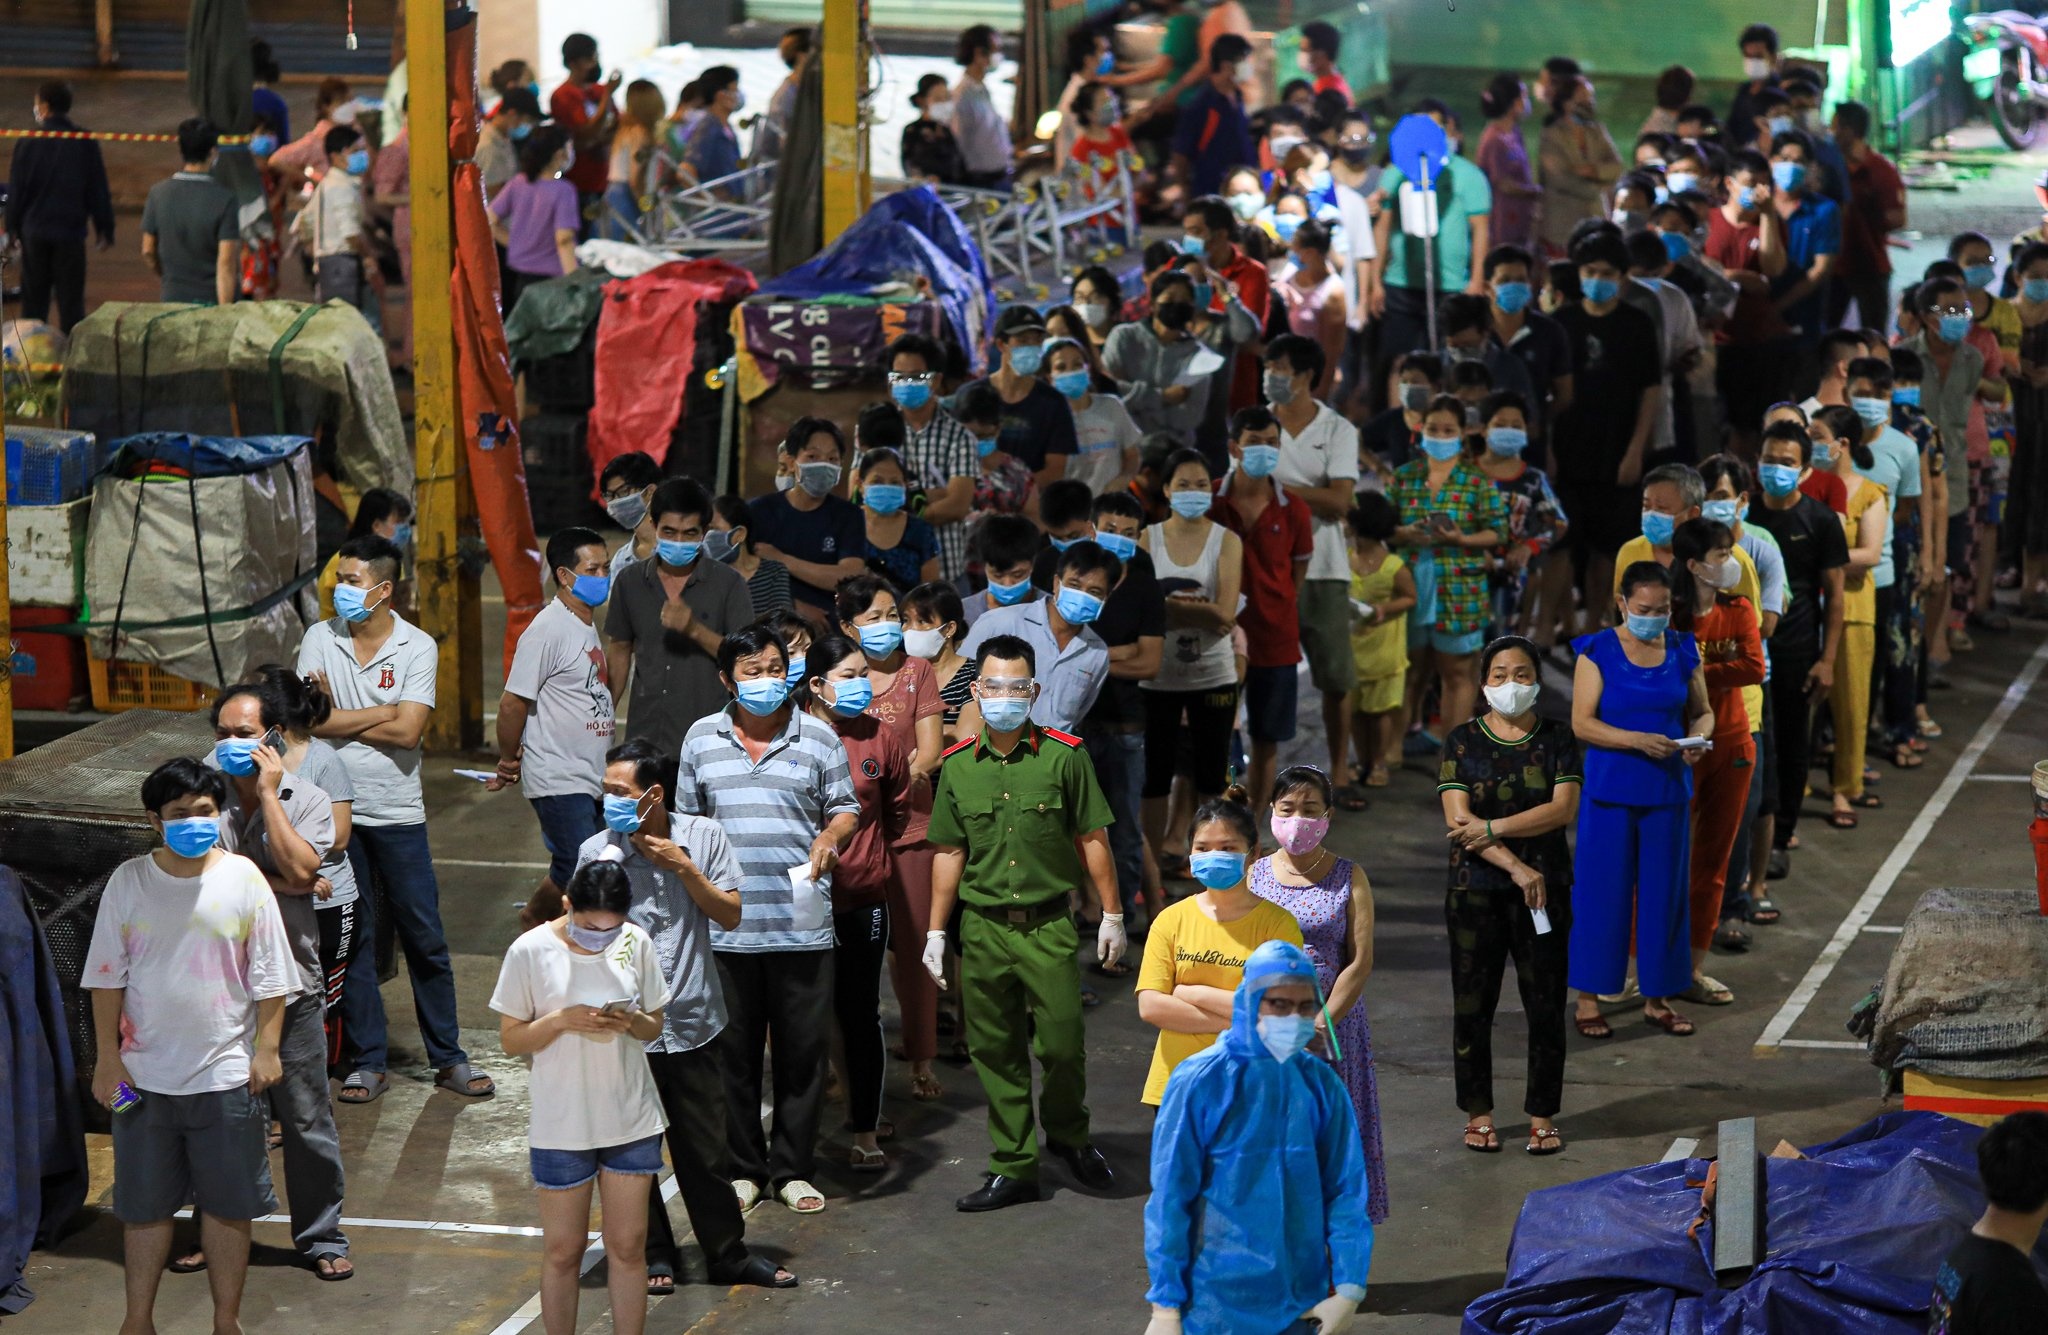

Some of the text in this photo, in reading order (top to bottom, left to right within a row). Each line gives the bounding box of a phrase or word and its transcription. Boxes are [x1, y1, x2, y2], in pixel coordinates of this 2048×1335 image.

[342, 916, 354, 933] OFF
[871, 908, 881, 941] GUCCI
[336, 933, 351, 959] START
